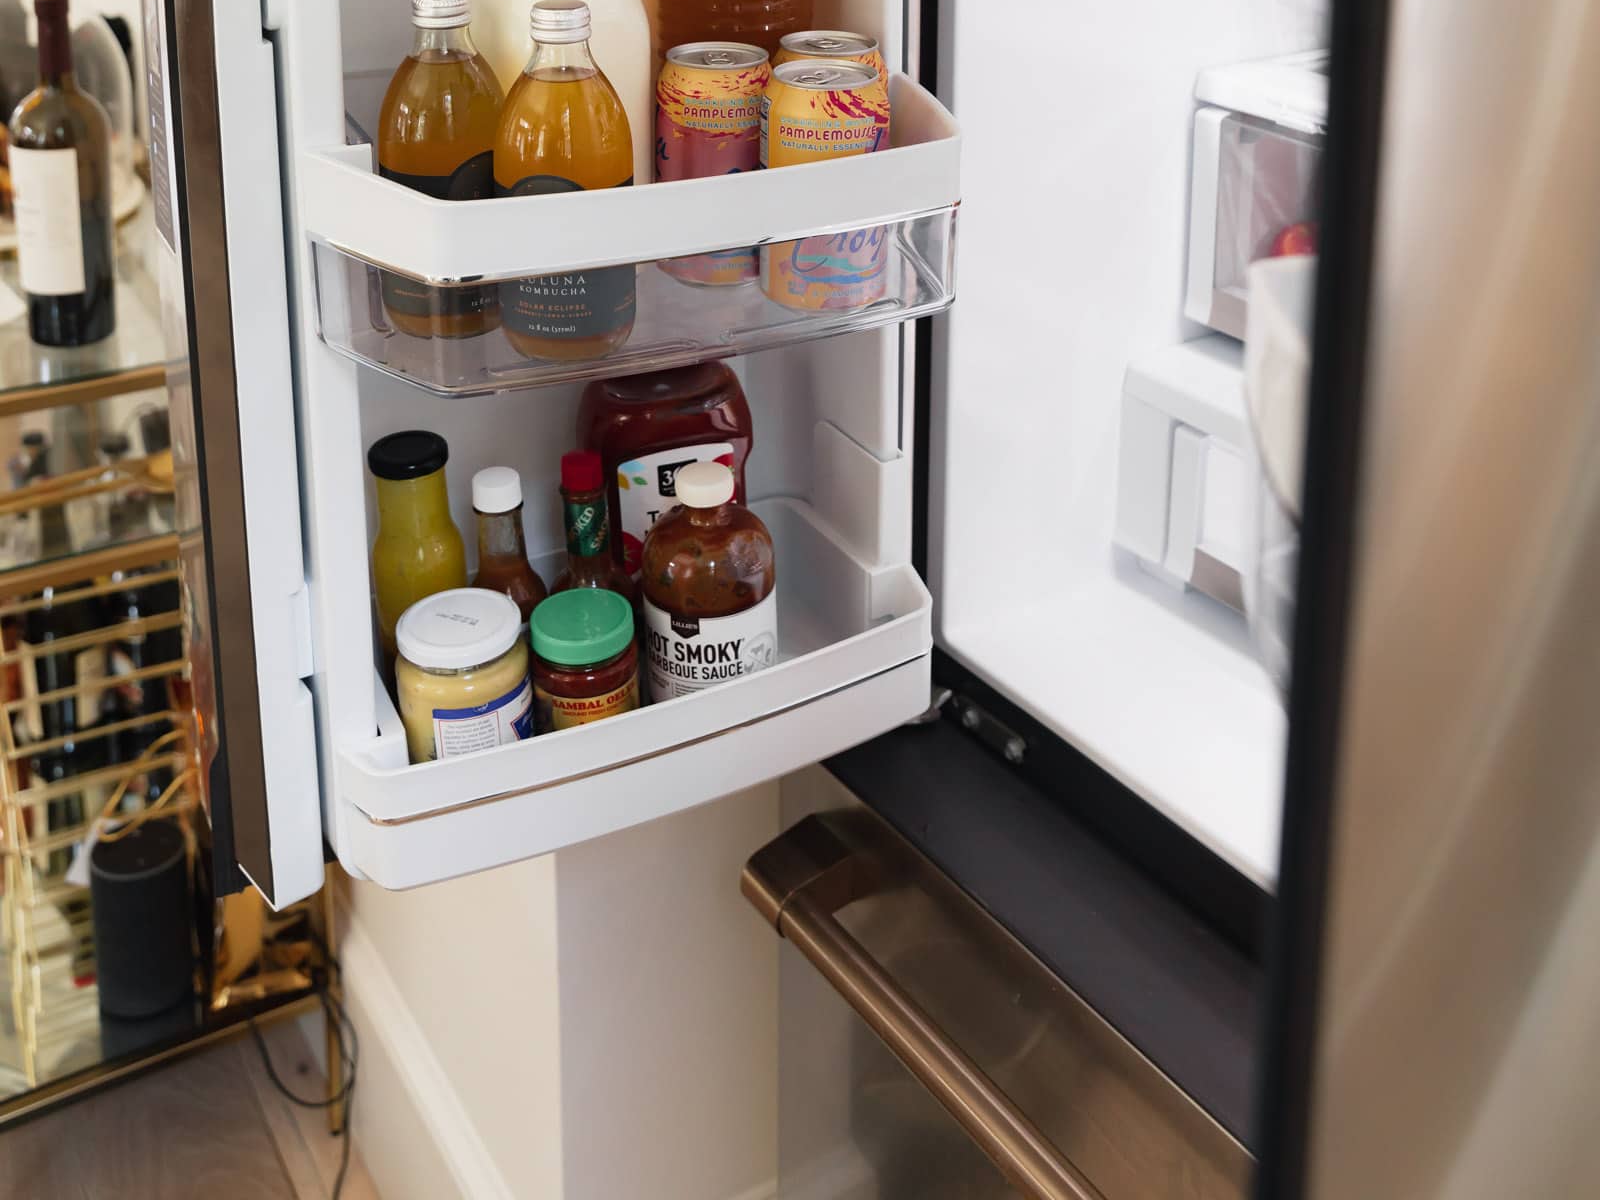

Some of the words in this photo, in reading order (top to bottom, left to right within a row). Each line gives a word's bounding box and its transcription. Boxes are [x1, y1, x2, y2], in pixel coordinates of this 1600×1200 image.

[520, 285, 587, 296] KOMBUCHA
[674, 638, 742, 665] SMOKY
[701, 660, 743, 680] SAUCE
[552, 698, 604, 711] SAMBAL
